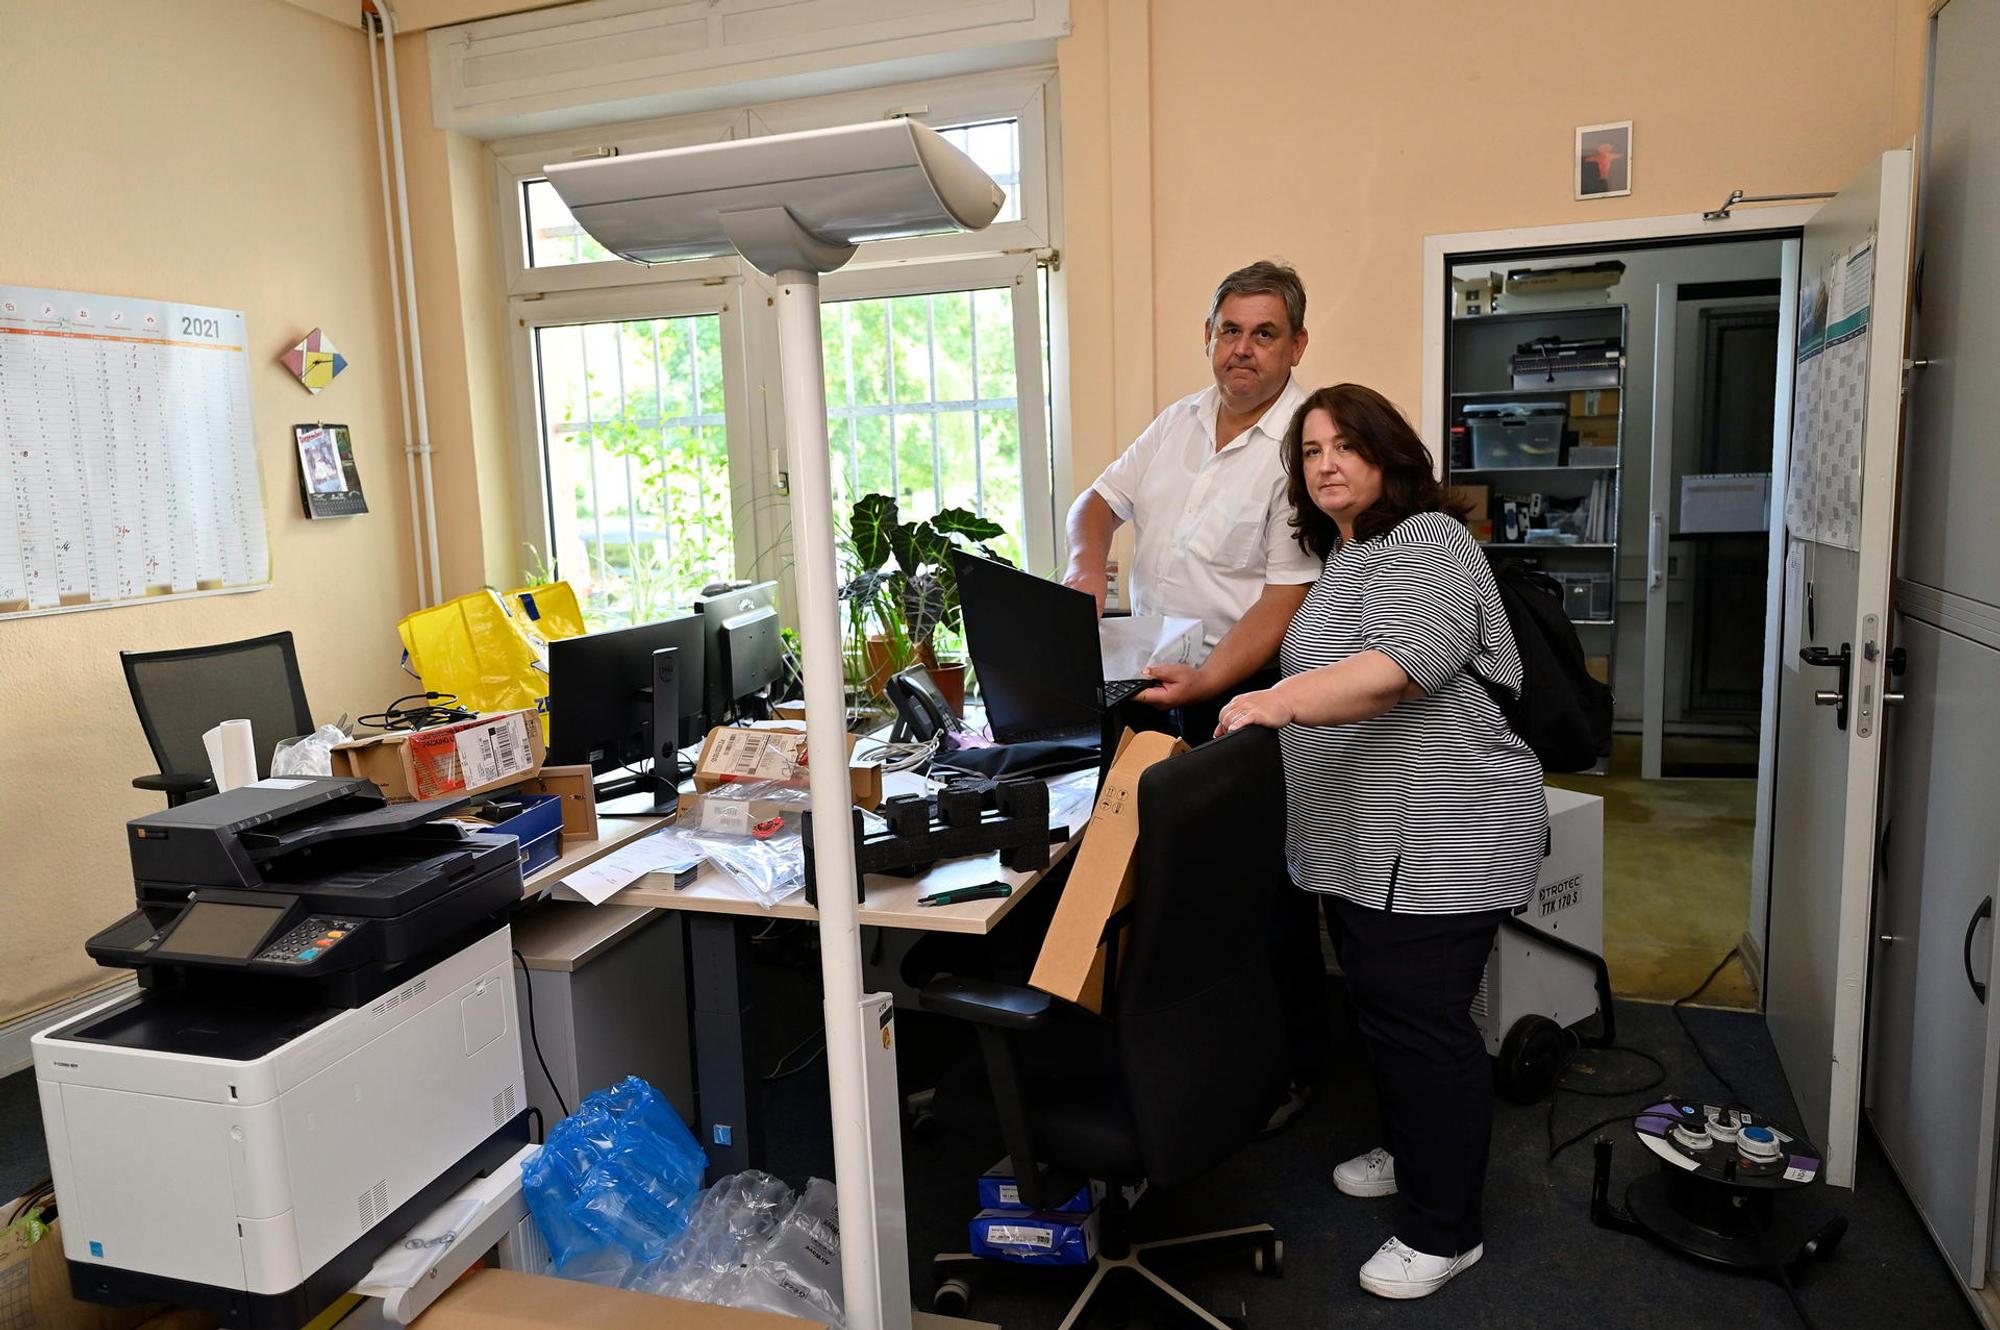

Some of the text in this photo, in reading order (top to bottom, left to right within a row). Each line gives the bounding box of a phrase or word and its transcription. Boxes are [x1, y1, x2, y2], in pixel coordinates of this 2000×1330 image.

[181, 316, 220, 339] 2021
[1546, 876, 1580, 897] TROTEC
[1558, 893, 1571, 909] 170
